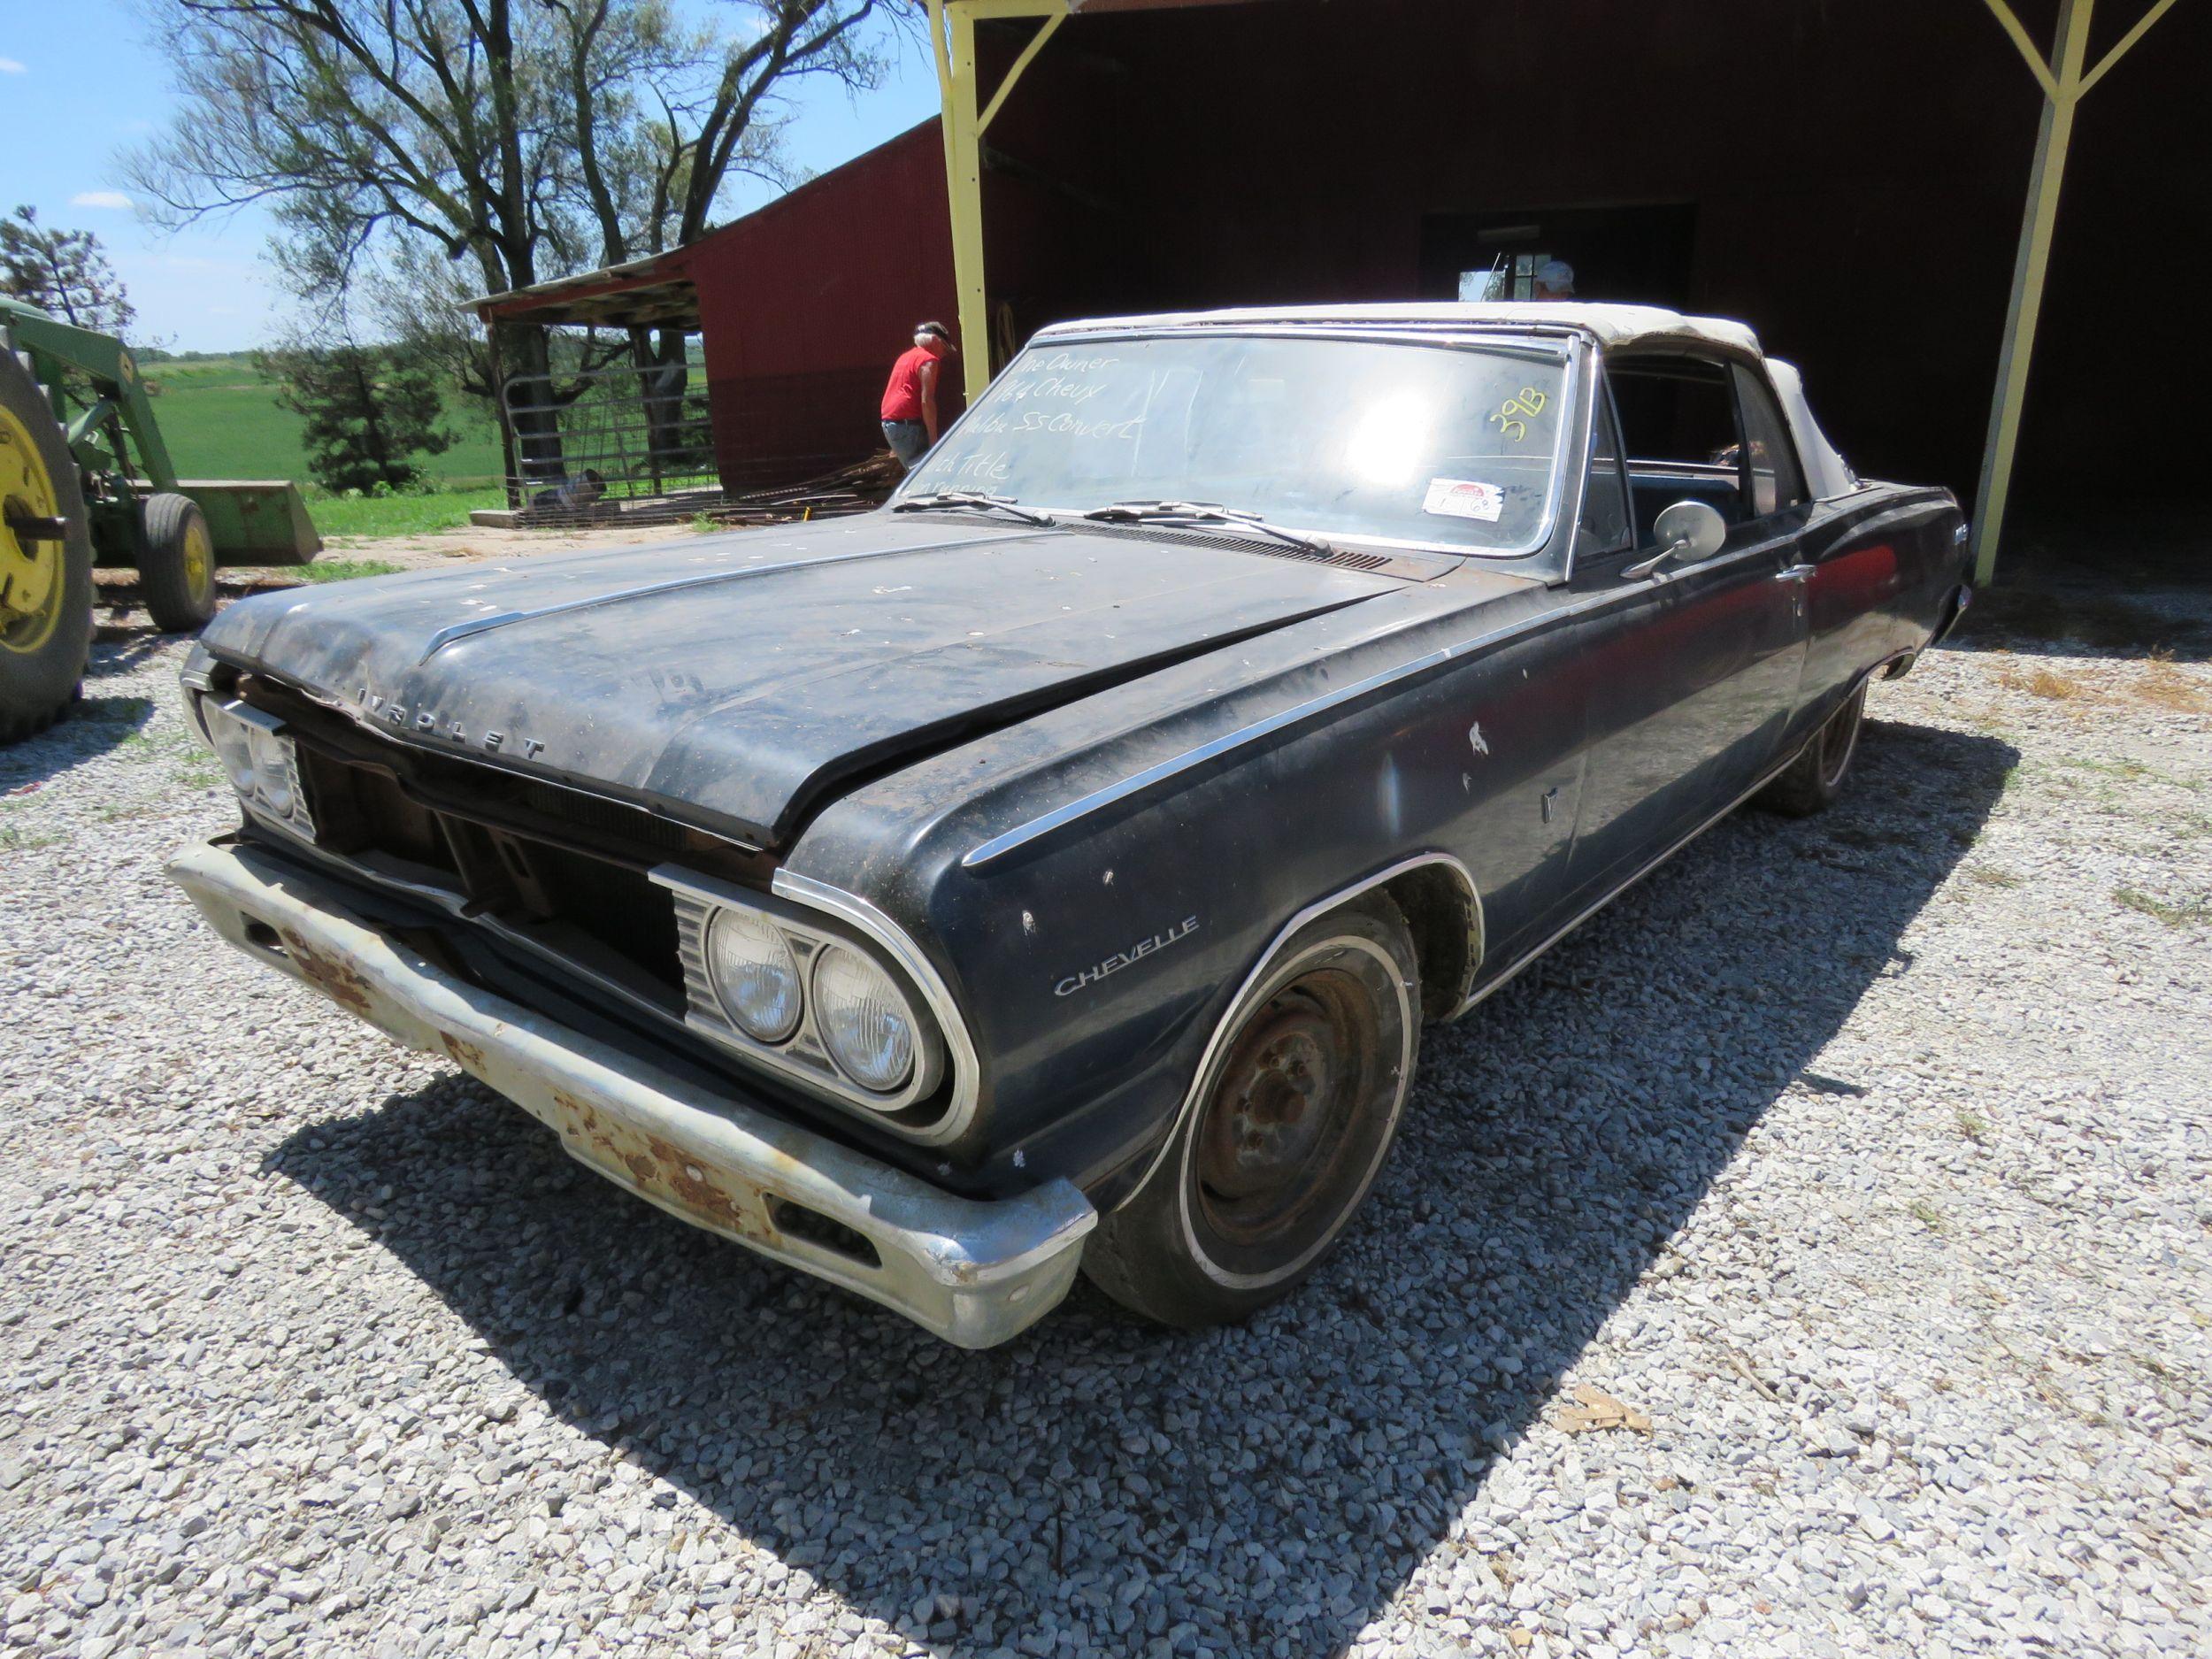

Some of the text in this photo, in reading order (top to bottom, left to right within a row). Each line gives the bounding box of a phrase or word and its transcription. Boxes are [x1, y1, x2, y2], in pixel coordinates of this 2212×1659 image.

[1046, 354, 1119, 373] Owner
[1033, 377, 1106, 404] Chevy
[1013, 411, 1050, 431] SS
[1048, 413, 1147, 438] Convert
[1489, 387, 1546, 442] 39B
[957, 452, 1010, 480] Title
[1054, 915, 1200, 996] CHEVELLE
